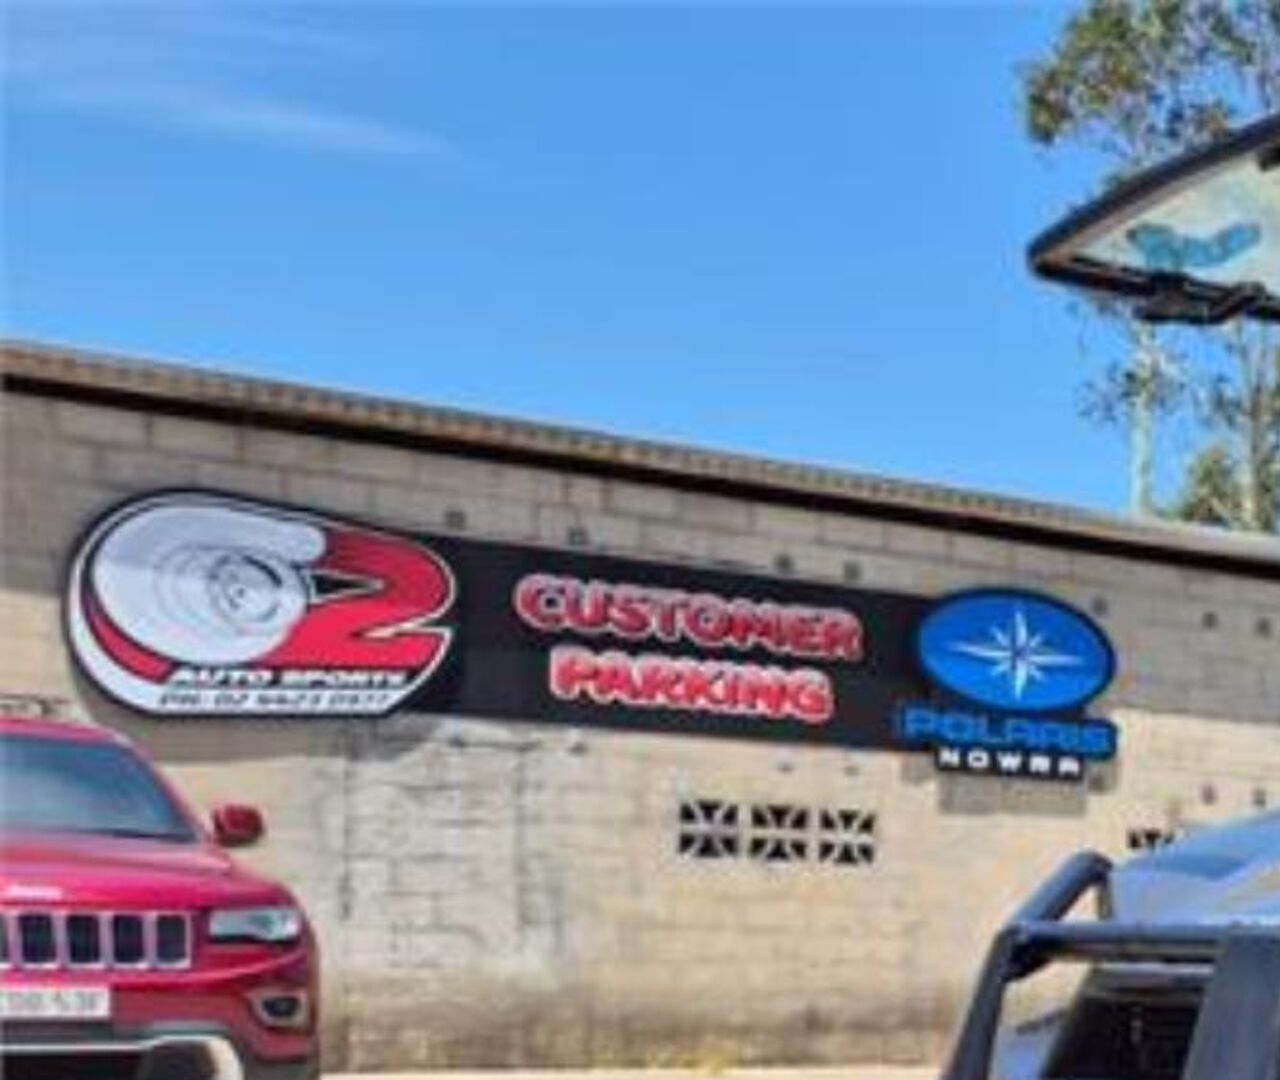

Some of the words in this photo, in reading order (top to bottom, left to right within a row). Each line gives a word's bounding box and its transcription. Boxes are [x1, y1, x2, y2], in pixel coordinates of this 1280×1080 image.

[512, 574, 864, 662] CUSTOMER
[166, 668, 272, 688] AUTO
[281, 668, 408, 688] SPORTS
[549, 645, 834, 719] PARKING
[903, 706, 1112, 752] POLARIS
[938, 748, 1081, 776] NOWRA
